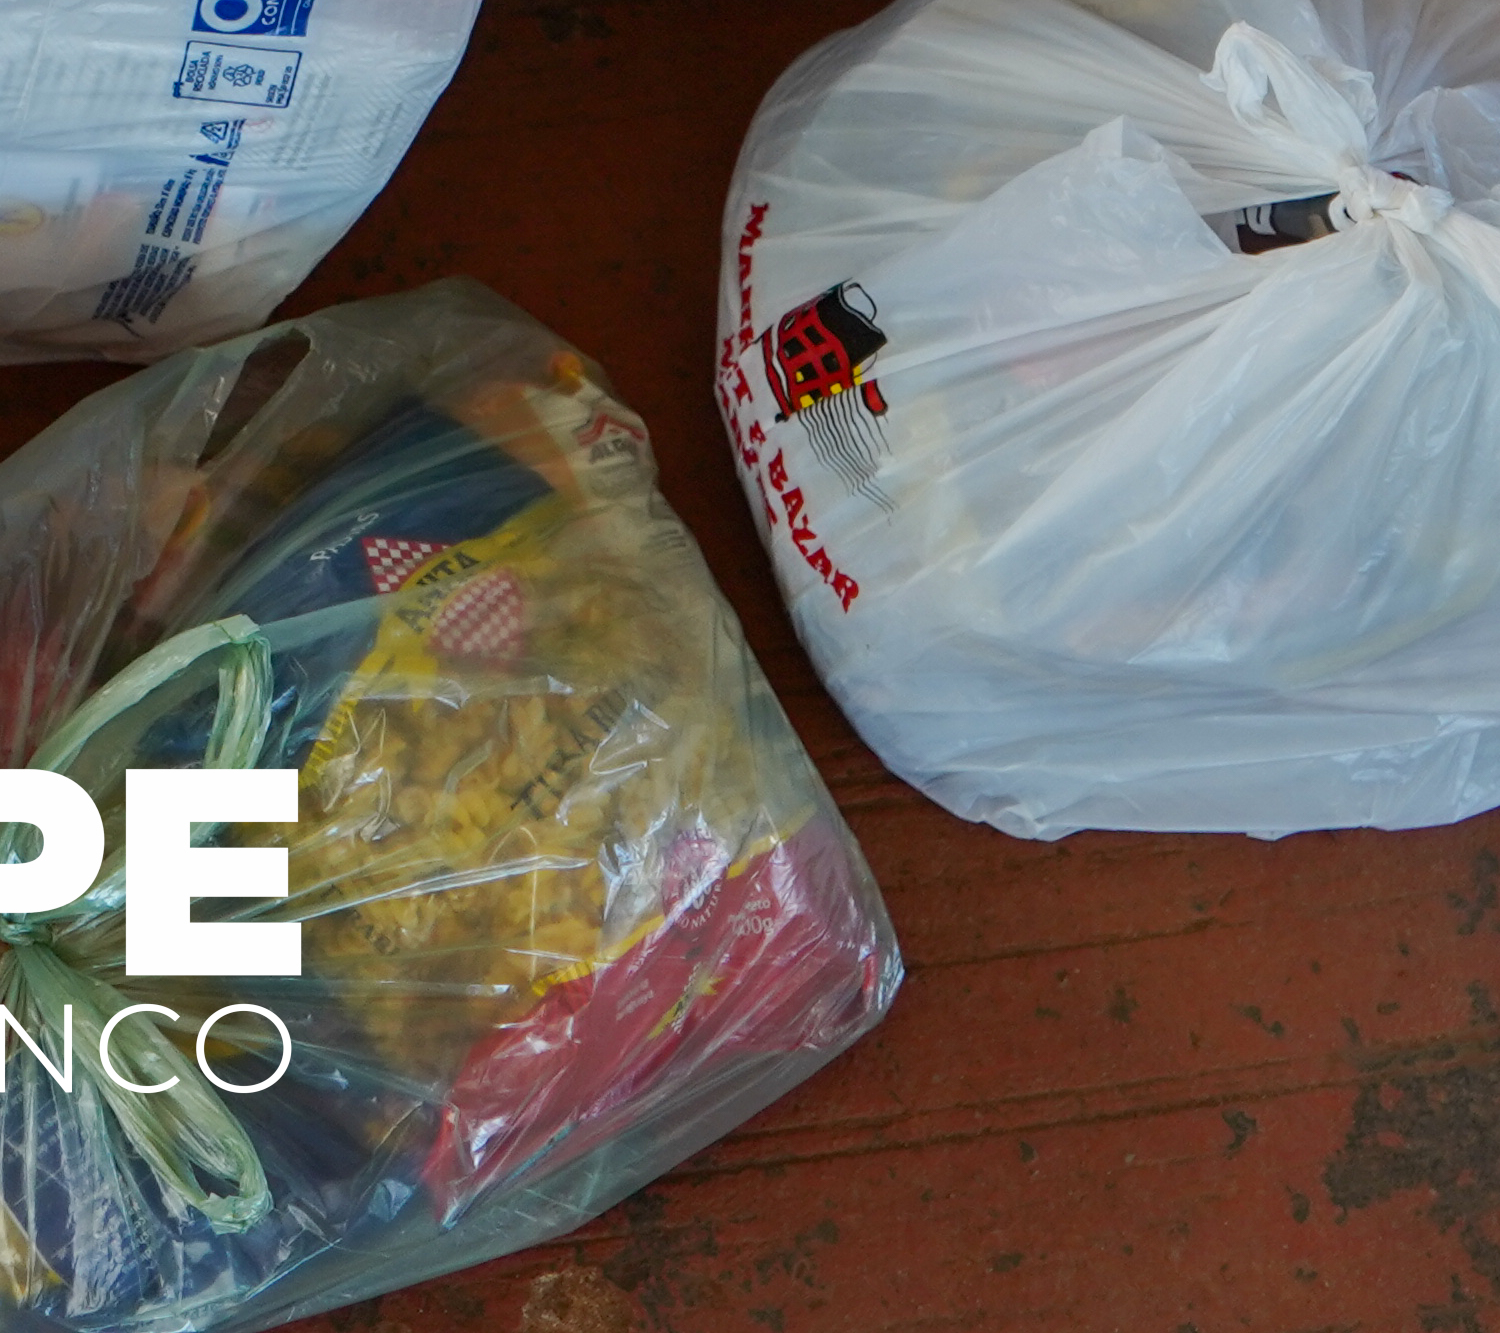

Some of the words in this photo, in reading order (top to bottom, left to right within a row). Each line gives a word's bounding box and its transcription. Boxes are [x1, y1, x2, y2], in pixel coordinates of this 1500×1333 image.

[185, 59, 198, 82] BOLSA
[194, 50, 211, 91] RECICLADA
[768, 449, 859, 613] BAZAR
